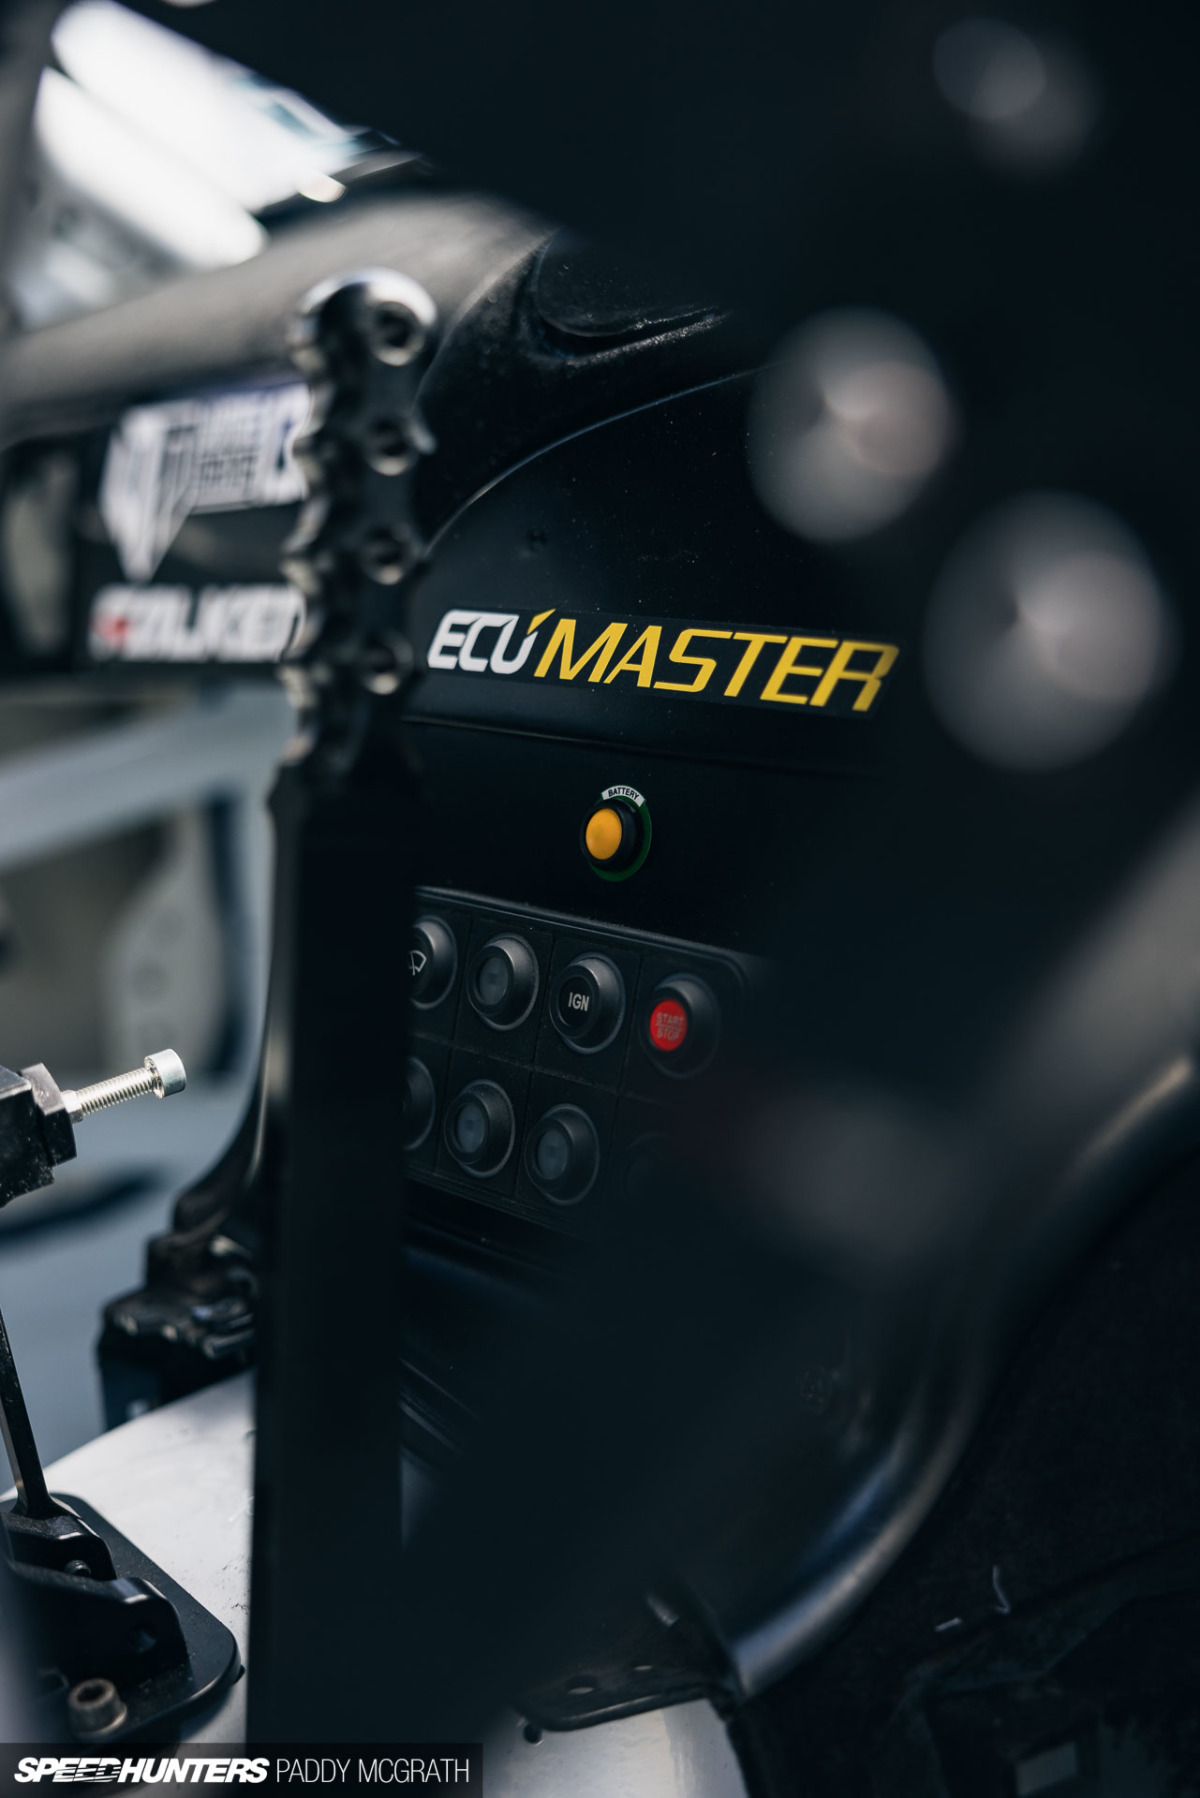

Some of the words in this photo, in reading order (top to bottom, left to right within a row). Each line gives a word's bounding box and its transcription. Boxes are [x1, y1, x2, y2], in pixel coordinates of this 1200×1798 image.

[608, 787, 639, 800] BATTERY
[568, 992, 589, 1012] IGN
[656, 1012, 684, 1026] START
[656, 1027, 680, 1041] STOP
